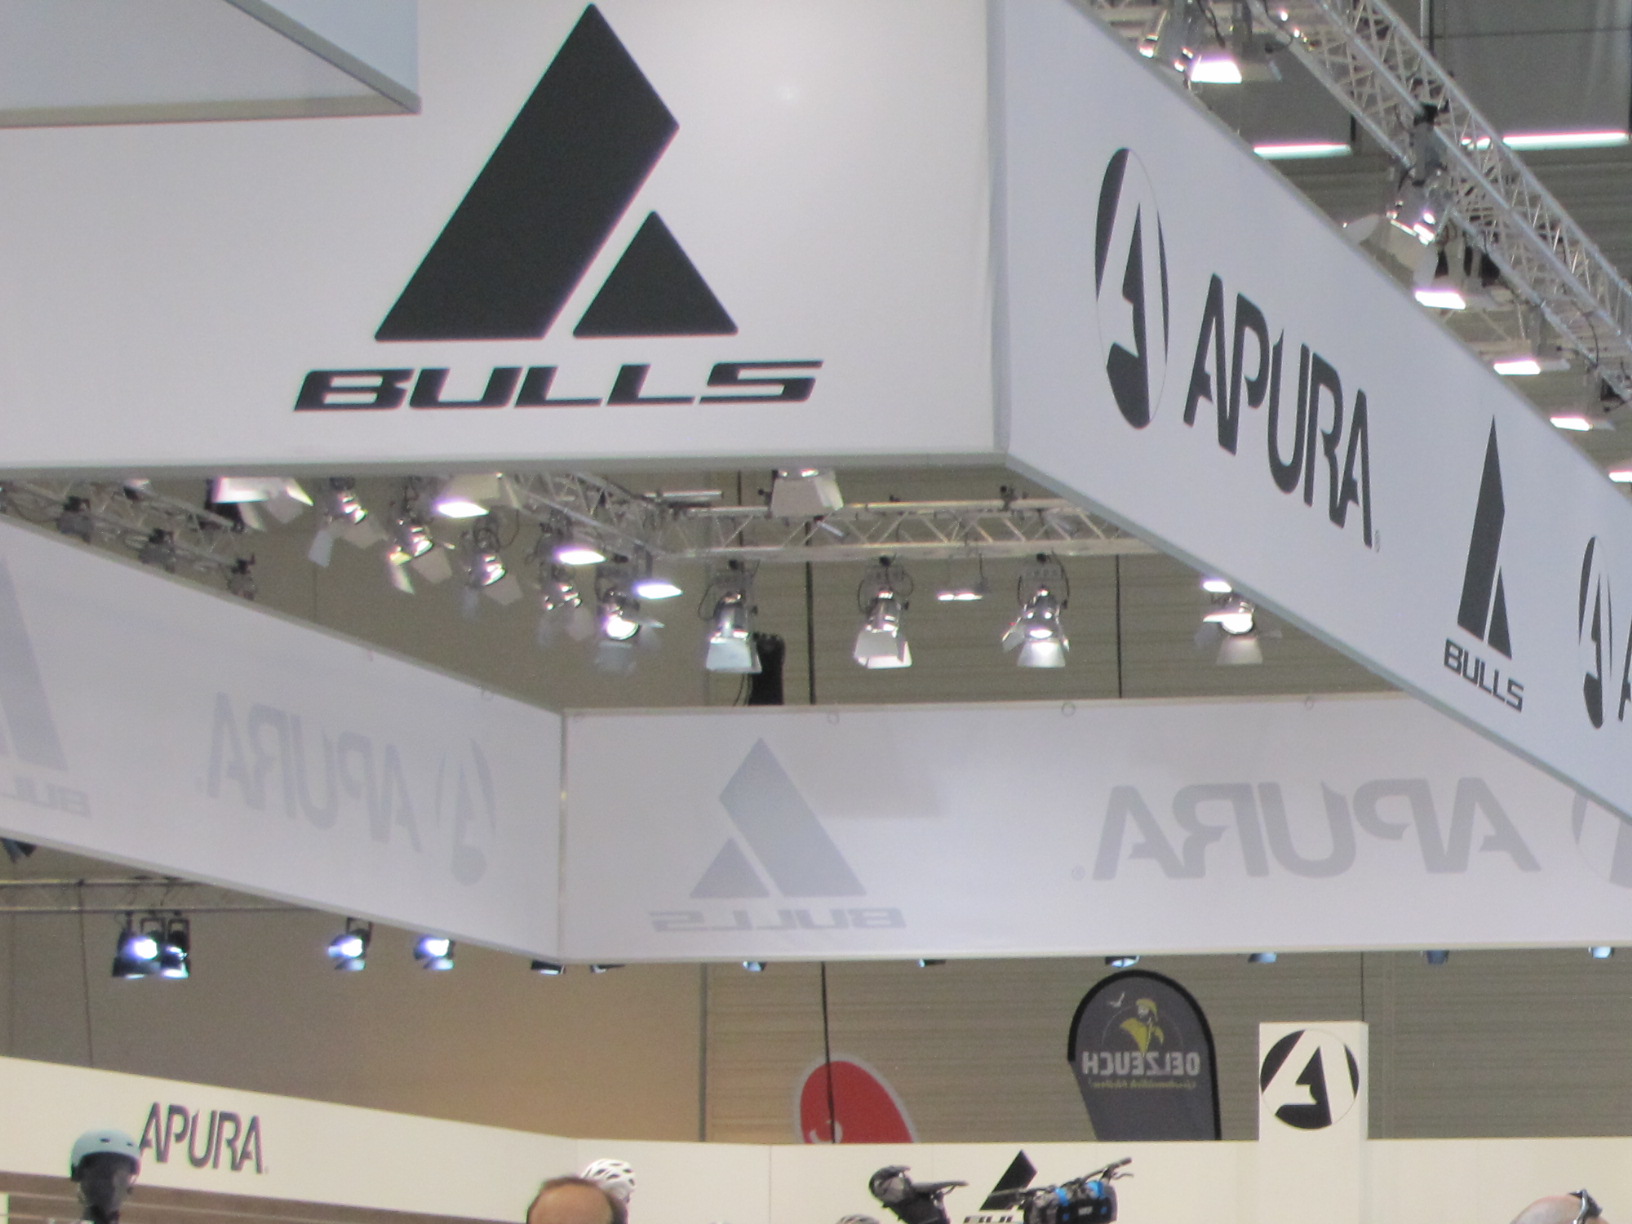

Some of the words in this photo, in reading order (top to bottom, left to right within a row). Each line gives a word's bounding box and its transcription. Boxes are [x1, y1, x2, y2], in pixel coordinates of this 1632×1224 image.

[293, 360, 823, 412] BULLS
[1183, 272, 1373, 549] APURA
[1443, 638, 1524, 712] BULLS
[138, 1101, 264, 1175] APURA
